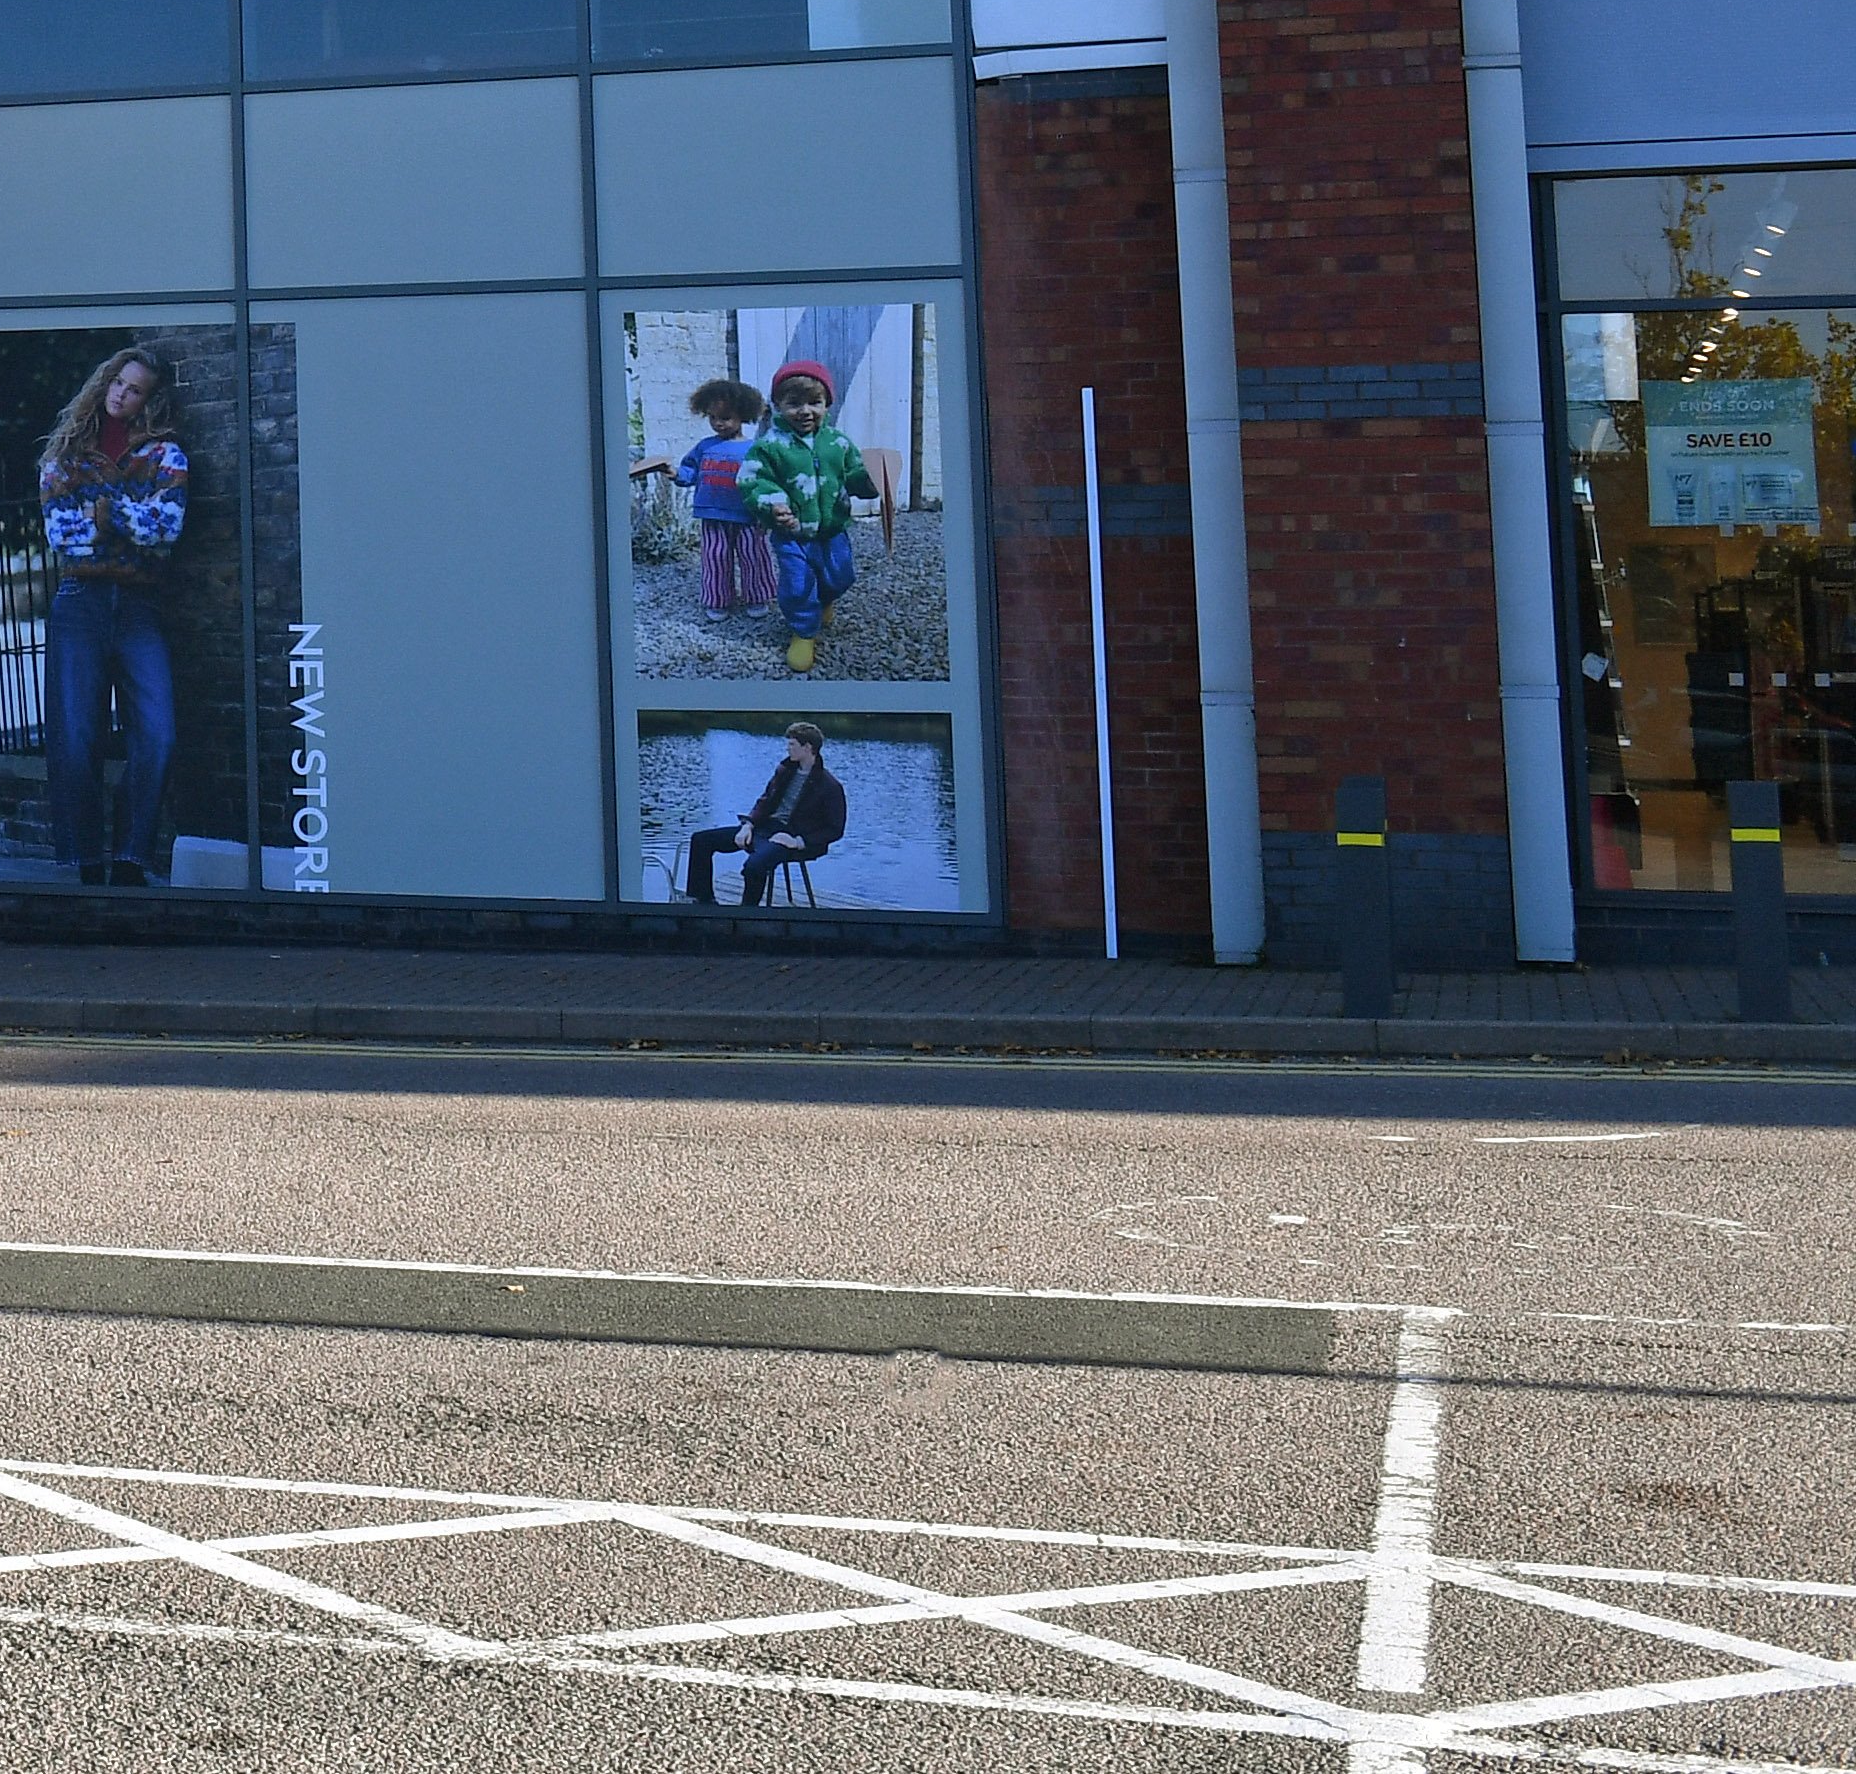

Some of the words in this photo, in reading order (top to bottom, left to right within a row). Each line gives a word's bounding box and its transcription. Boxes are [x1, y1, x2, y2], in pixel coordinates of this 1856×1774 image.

[1686, 433, 1735, 448] SAVE
[1739, 432, 1773, 447] £10
[288, 624, 326, 738] NEW
